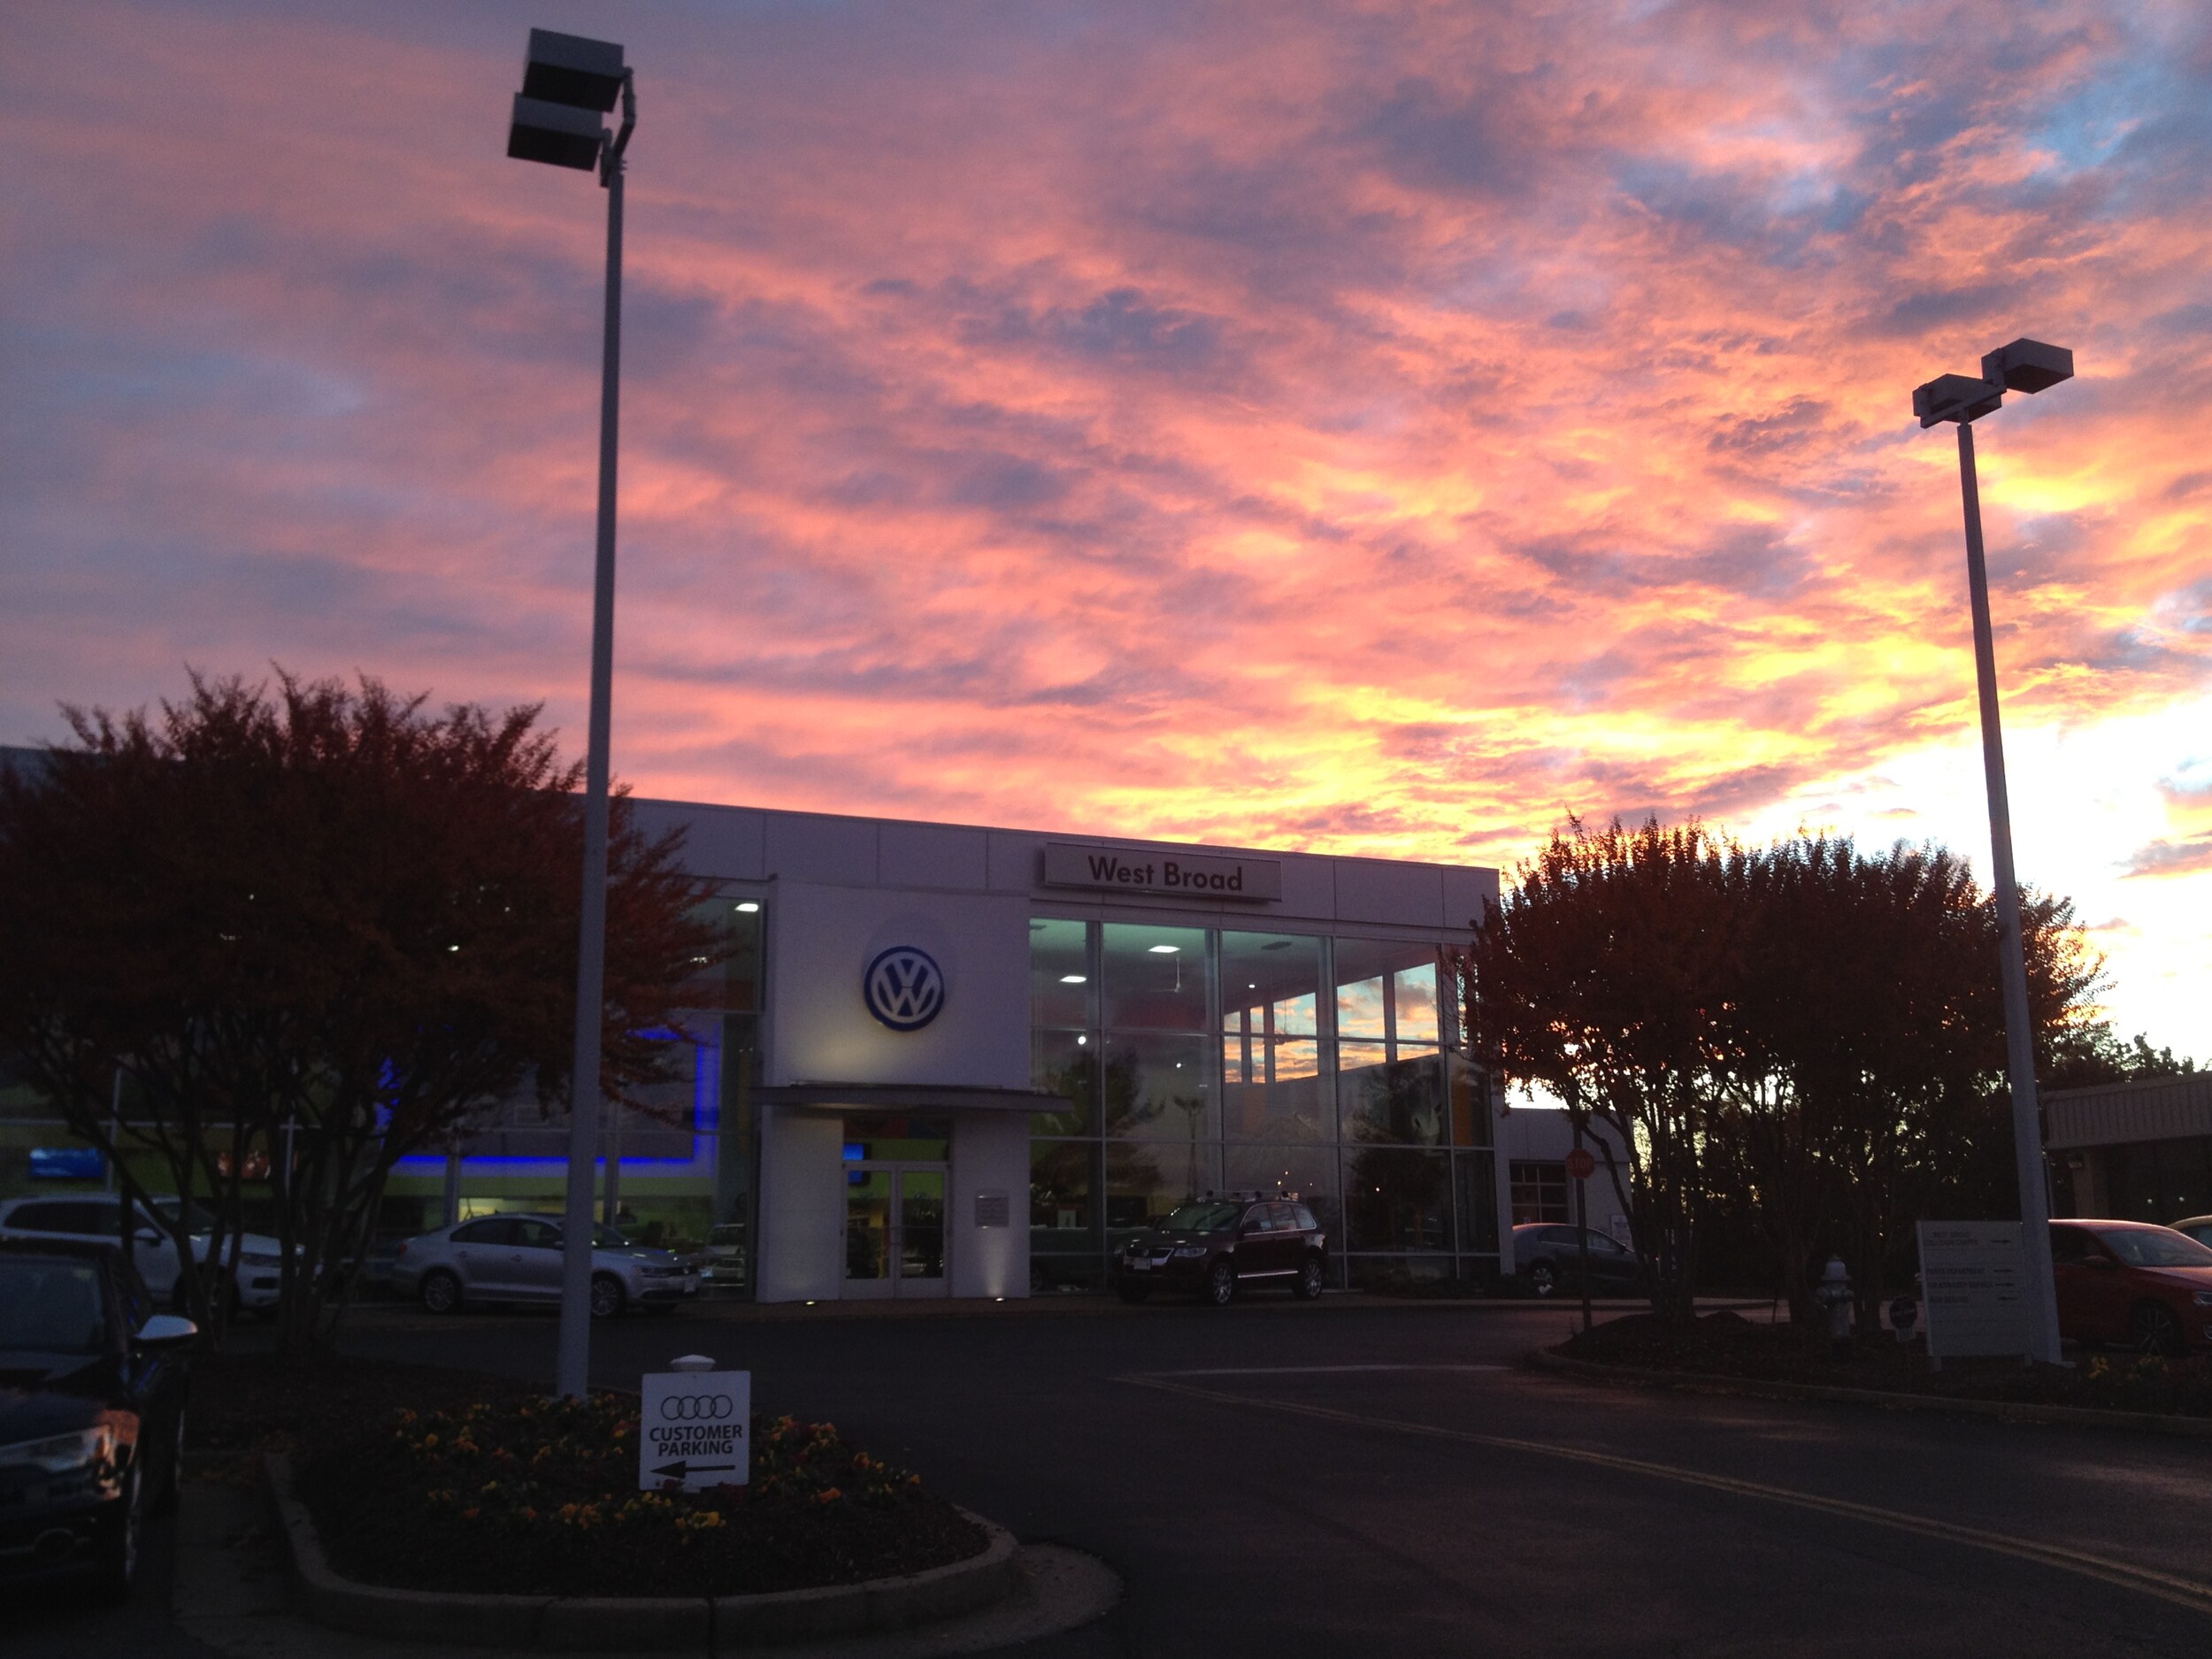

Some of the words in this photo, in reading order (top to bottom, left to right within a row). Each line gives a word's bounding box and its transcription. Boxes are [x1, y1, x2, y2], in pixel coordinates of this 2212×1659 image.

[1087, 854, 1154, 884] West
[1164, 861, 1242, 892] Broad
[867, 949, 941, 1026] VW
[1567, 1156, 1592, 1169] STOP
[649, 1424, 742, 1442] CUSTOMER
[657, 1440, 733, 1457] PARKING
